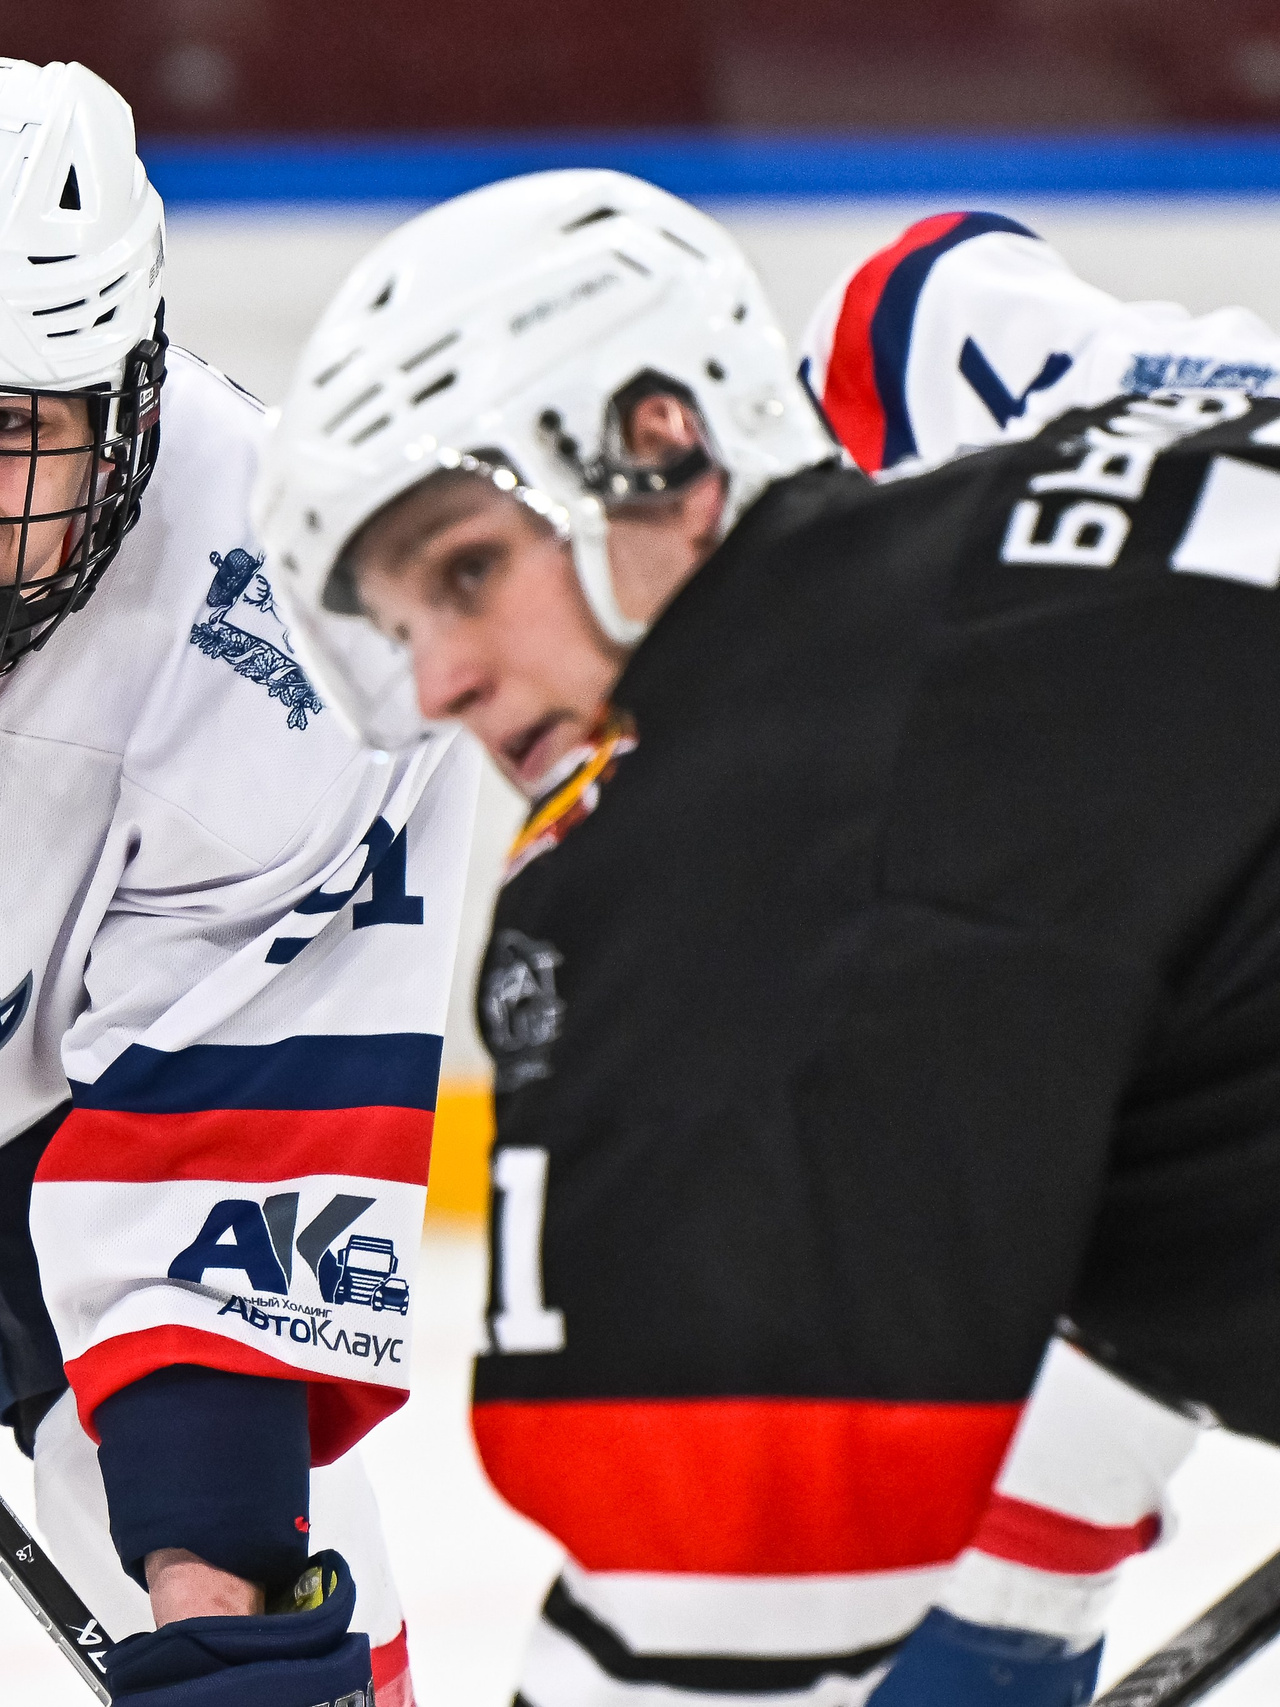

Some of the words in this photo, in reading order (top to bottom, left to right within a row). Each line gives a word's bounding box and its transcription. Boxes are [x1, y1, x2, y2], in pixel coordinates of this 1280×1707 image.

[476, 1145, 567, 1356] 1
[282, 1297, 333, 1320] Холдинг
[15, 1543, 34, 1561] 87
